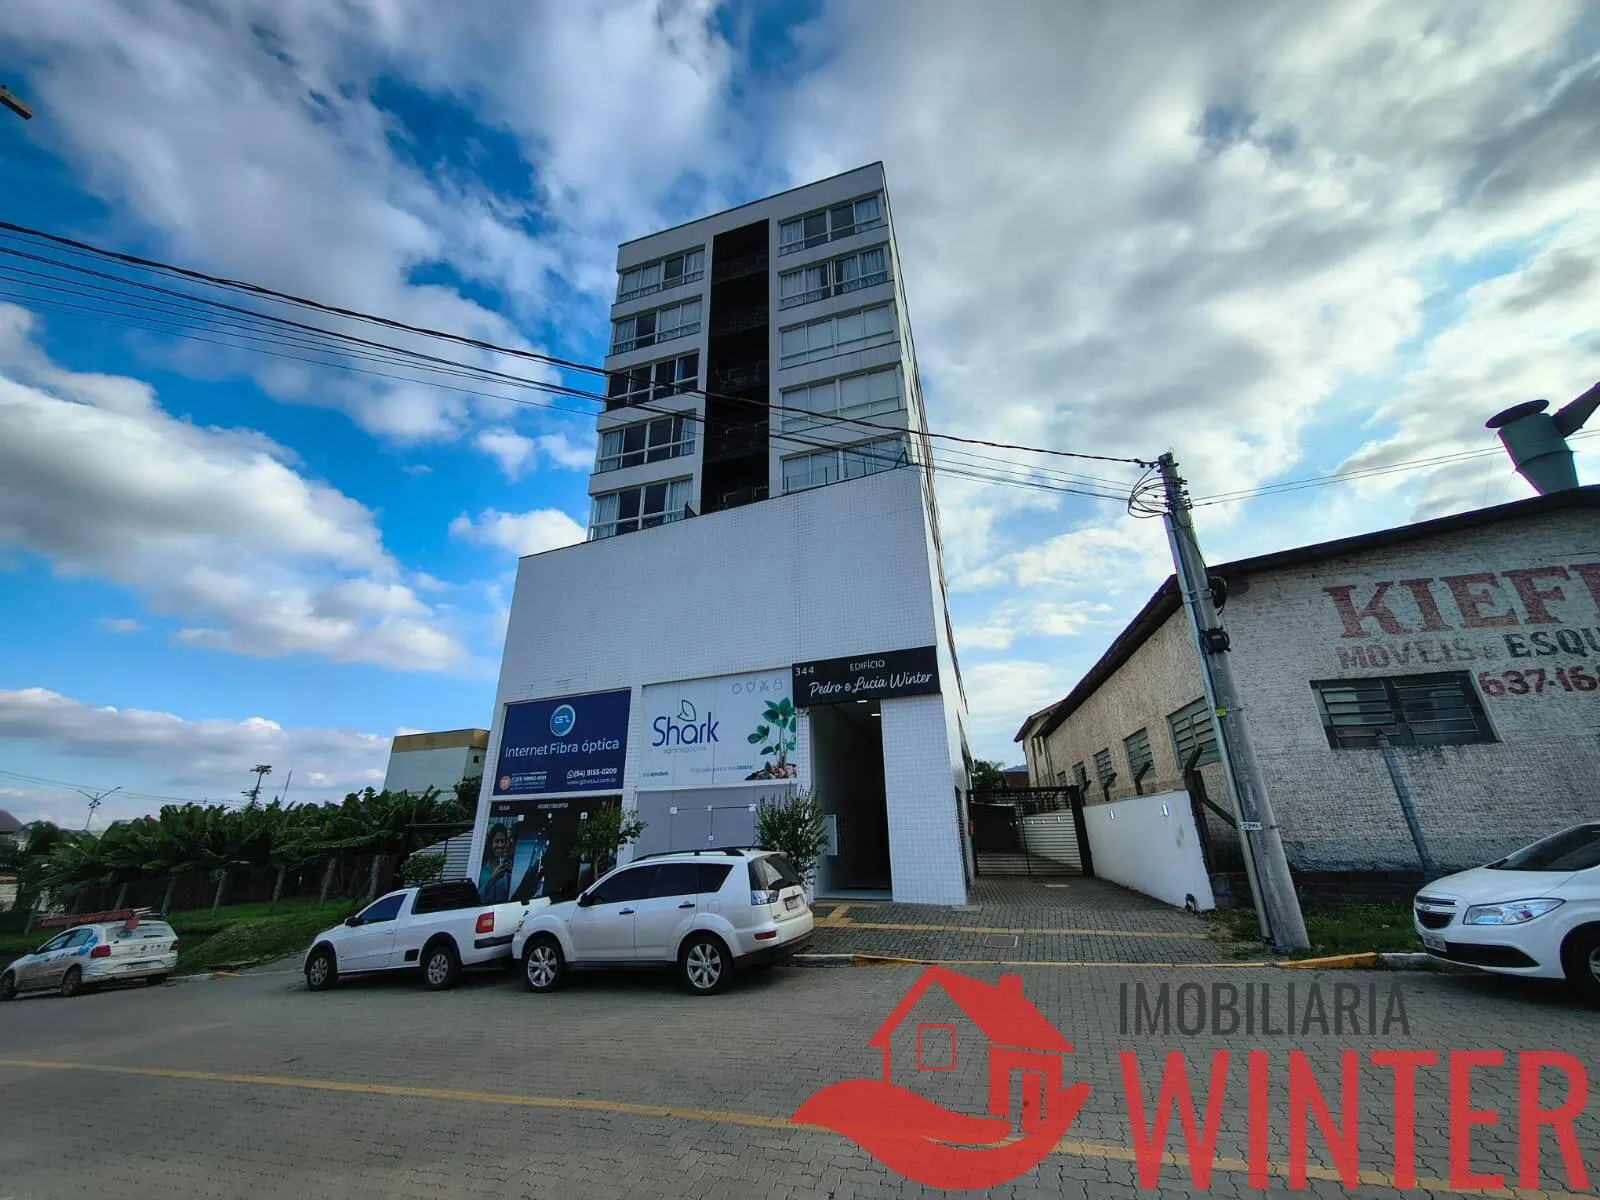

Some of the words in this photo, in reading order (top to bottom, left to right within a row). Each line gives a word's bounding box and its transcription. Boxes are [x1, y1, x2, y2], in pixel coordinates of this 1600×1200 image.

[795, 666, 815, 677] 344
[849, 659, 886, 672] EDIFÍCIO
[808, 682, 843, 697] Pedro
[844, 684, 852, 692] e
[852, 675, 887, 694] Lucia
[889, 671, 932, 688] Winter
[1478, 665, 1600, 696] 637-16
[652, 711, 720, 747] Shark
[505, 745, 548, 758] Internet
[549, 742, 578, 755] Fibra
[581, 738, 620, 755] óptica
